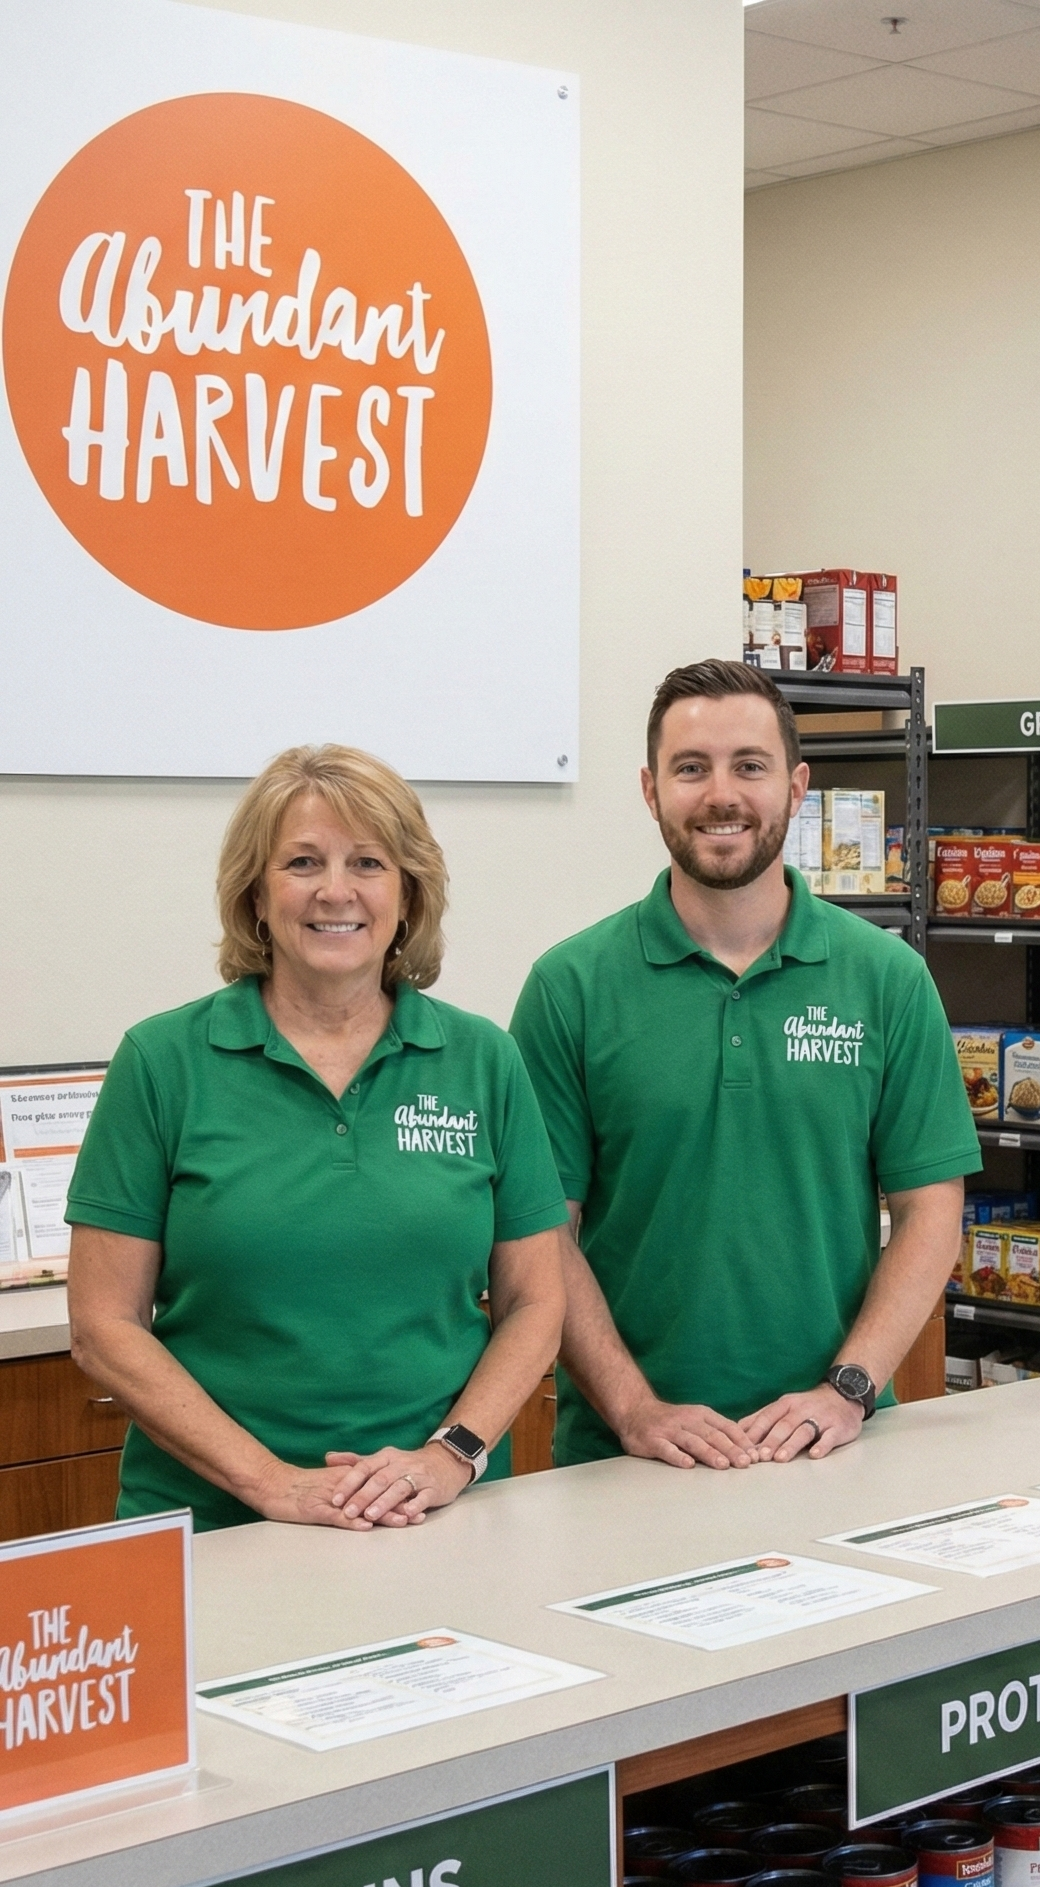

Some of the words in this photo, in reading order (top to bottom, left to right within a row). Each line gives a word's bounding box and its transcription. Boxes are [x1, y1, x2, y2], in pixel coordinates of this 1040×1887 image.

[184, 188, 275, 277] THE
[59, 231, 446, 375] Abundant
[62, 358, 436, 517] HARVEST
[806, 1005, 828, 1021] THE
[787, 1037, 863, 1067] HARVEST
[416, 1093, 440, 1111] THE
[397, 1127, 477, 1157] HARVEST
[28, 1604, 72, 1650] THE
